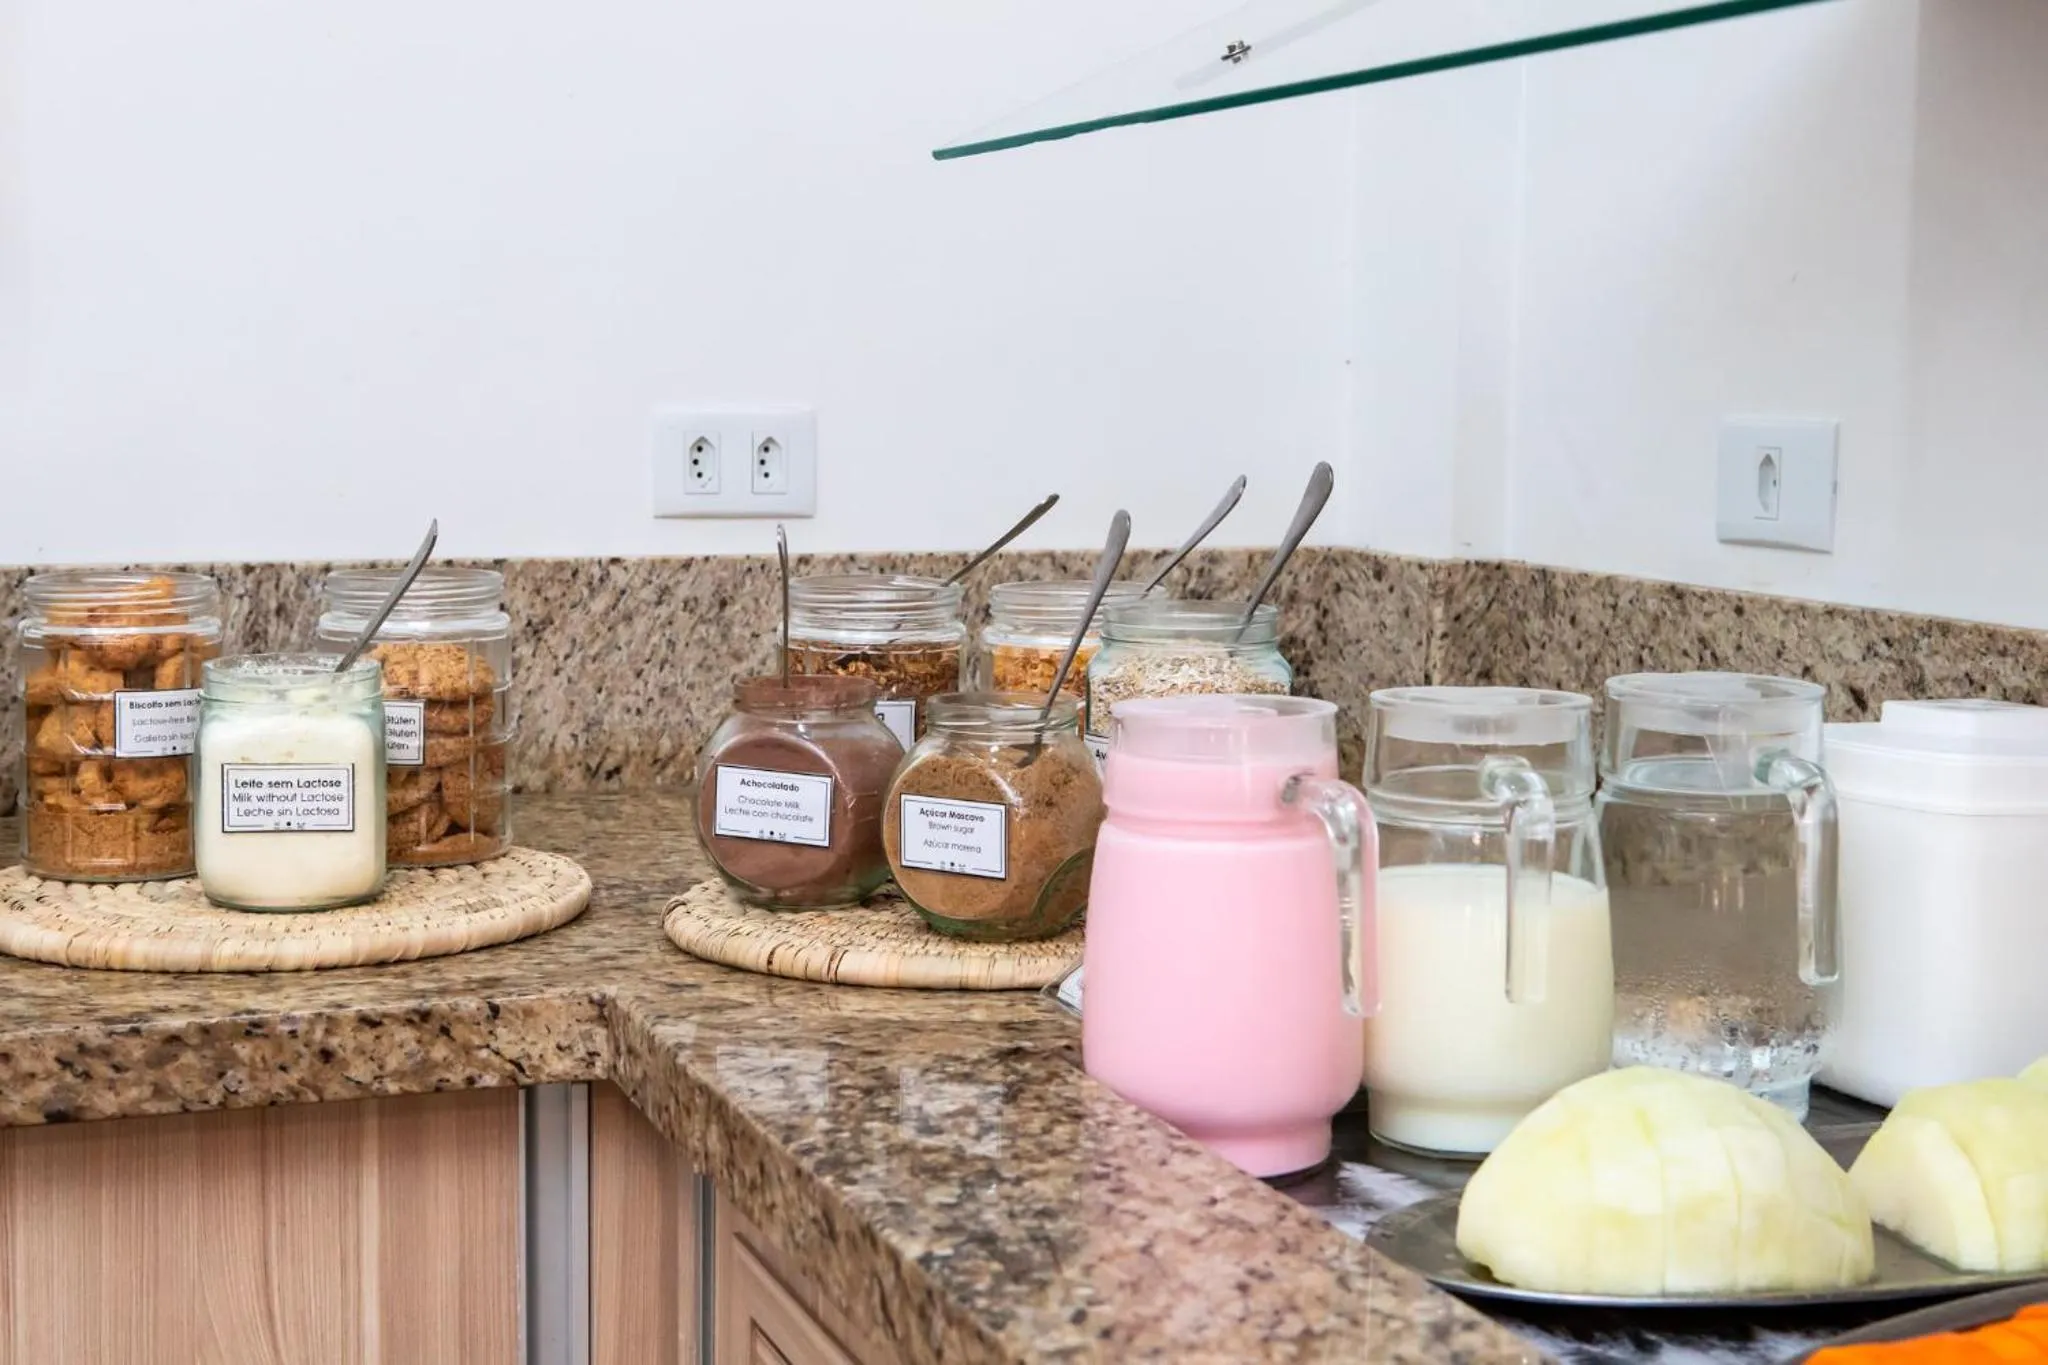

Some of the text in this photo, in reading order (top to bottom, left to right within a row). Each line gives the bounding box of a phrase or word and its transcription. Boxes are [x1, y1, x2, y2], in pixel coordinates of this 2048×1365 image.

[165, 700, 182, 708] sem
[235, 778, 342, 788] Leite sem Lactose
[740, 778, 800, 792] Achocolatado
[232, 792, 345, 802] Milk without Lactose
[738, 794, 800, 809] Chocolate Milk
[237, 806, 340, 817] Leche sin Lactosa
[724, 805, 814, 823] Leche con chocolate
[919, 806, 986, 823] Açúcar Mascavo
[928, 821, 975, 835] Brown sugar
[951, 842, 982, 854] morena
